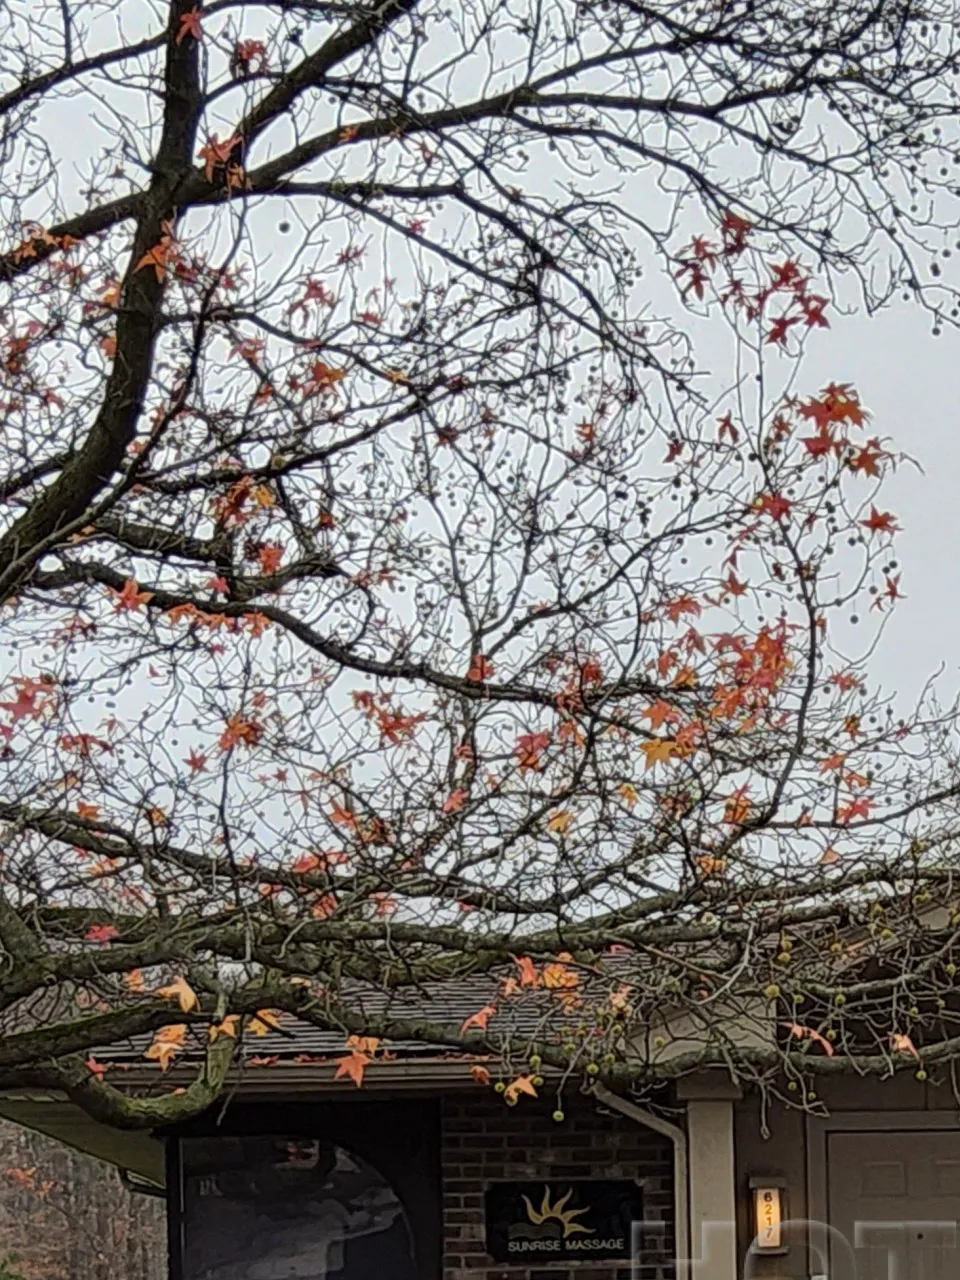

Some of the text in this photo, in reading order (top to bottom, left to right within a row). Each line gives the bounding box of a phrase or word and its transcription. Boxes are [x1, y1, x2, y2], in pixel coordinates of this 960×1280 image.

[763, 1191, 773, 1238] 6217
[508, 1239, 625, 1253] SUNRISE MASSAGE
